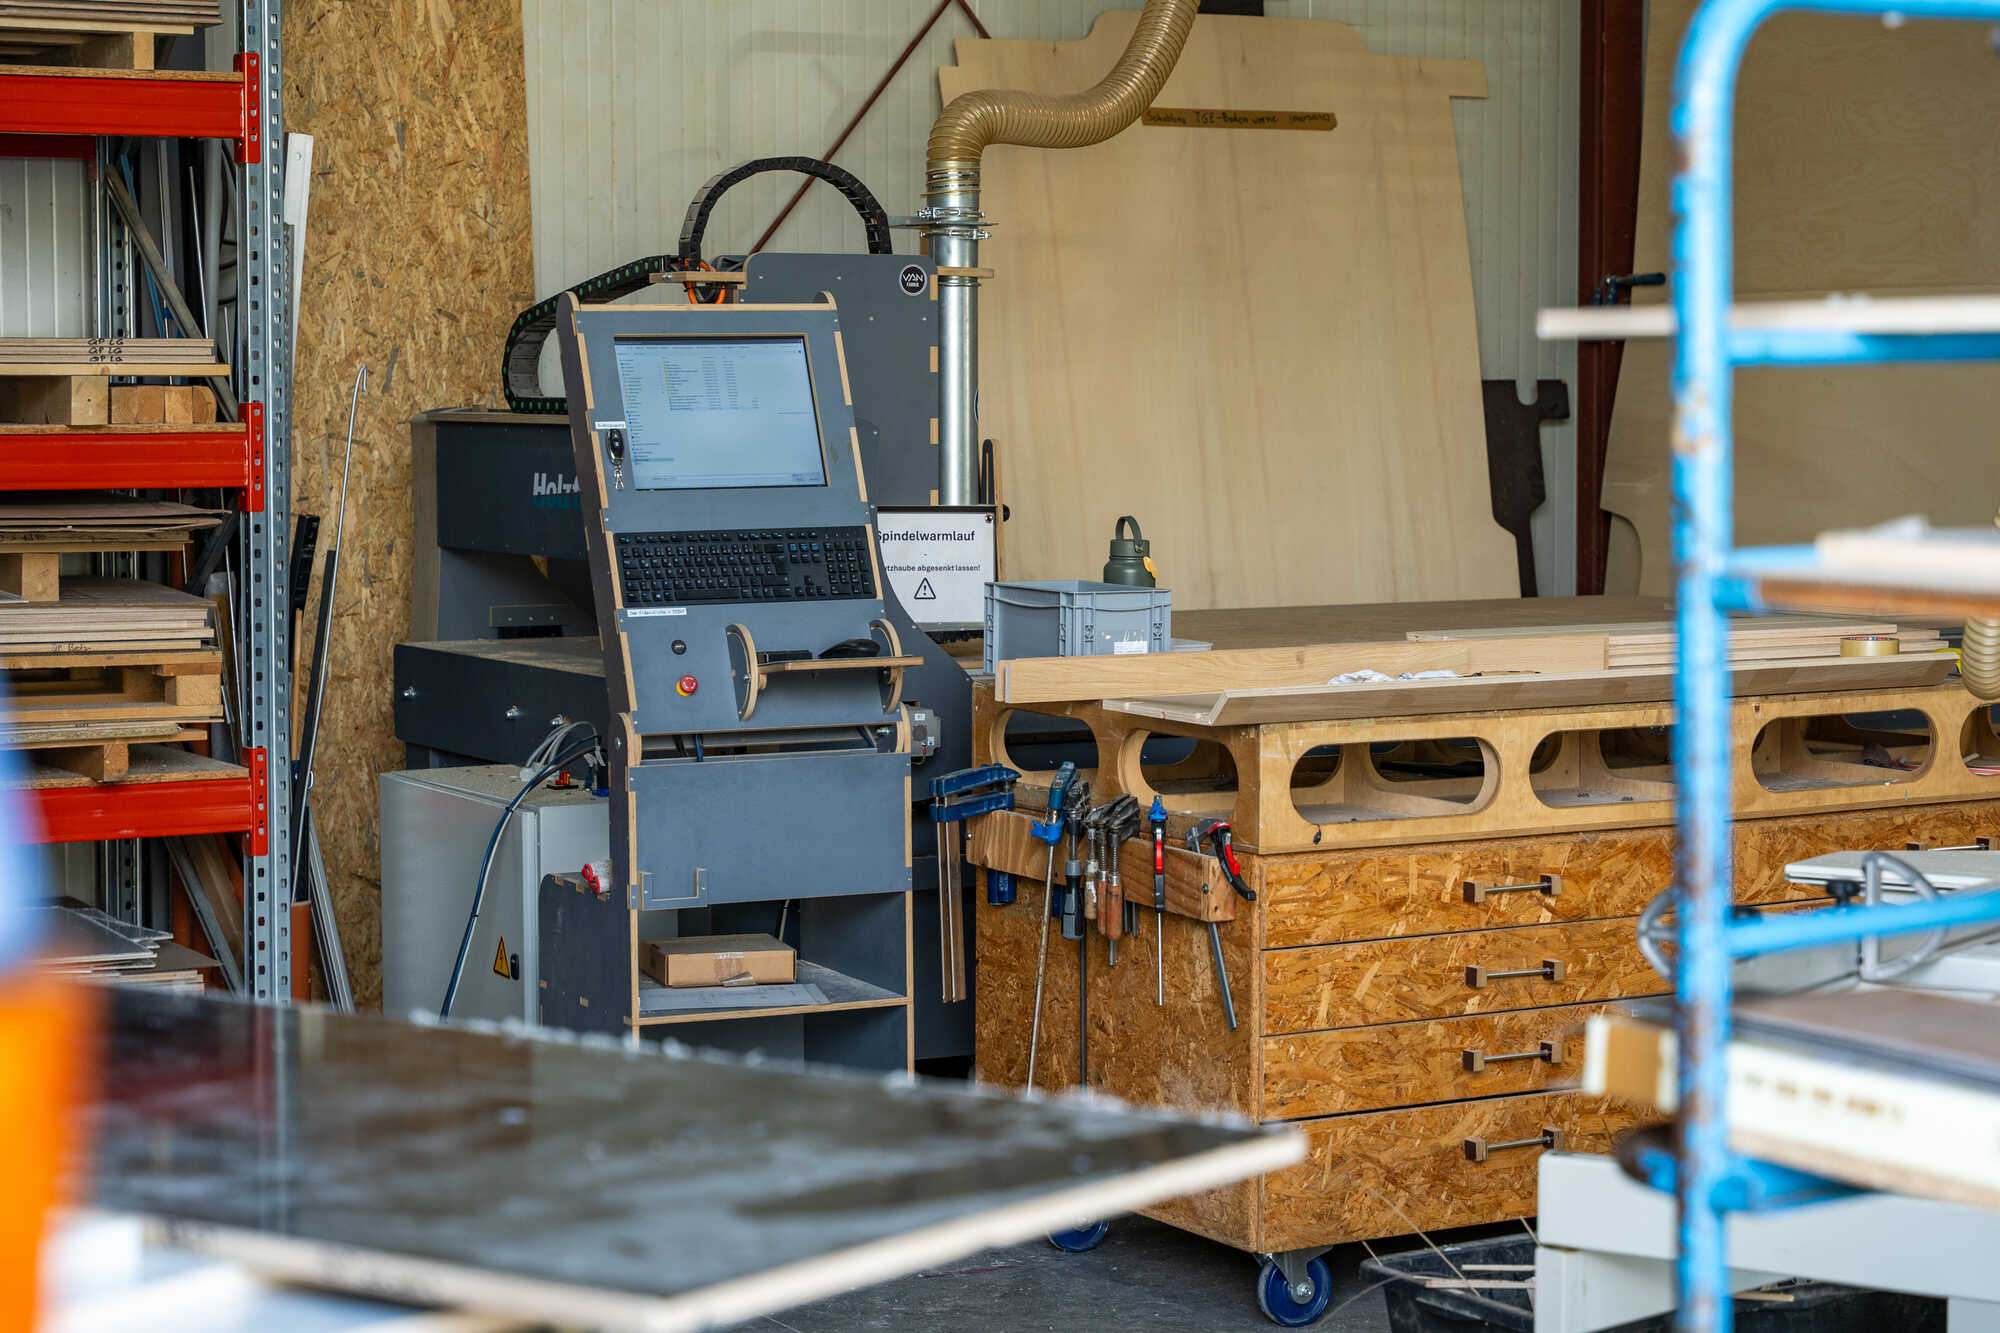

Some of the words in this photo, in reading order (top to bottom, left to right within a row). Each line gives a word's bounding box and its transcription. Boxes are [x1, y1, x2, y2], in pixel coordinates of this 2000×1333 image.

[902, 273, 923, 282] VAN
[885, 564, 916, 572] tzhaube
[917, 564, 954, 573] abgesenkt
[955, 564, 981, 572] lassen!
